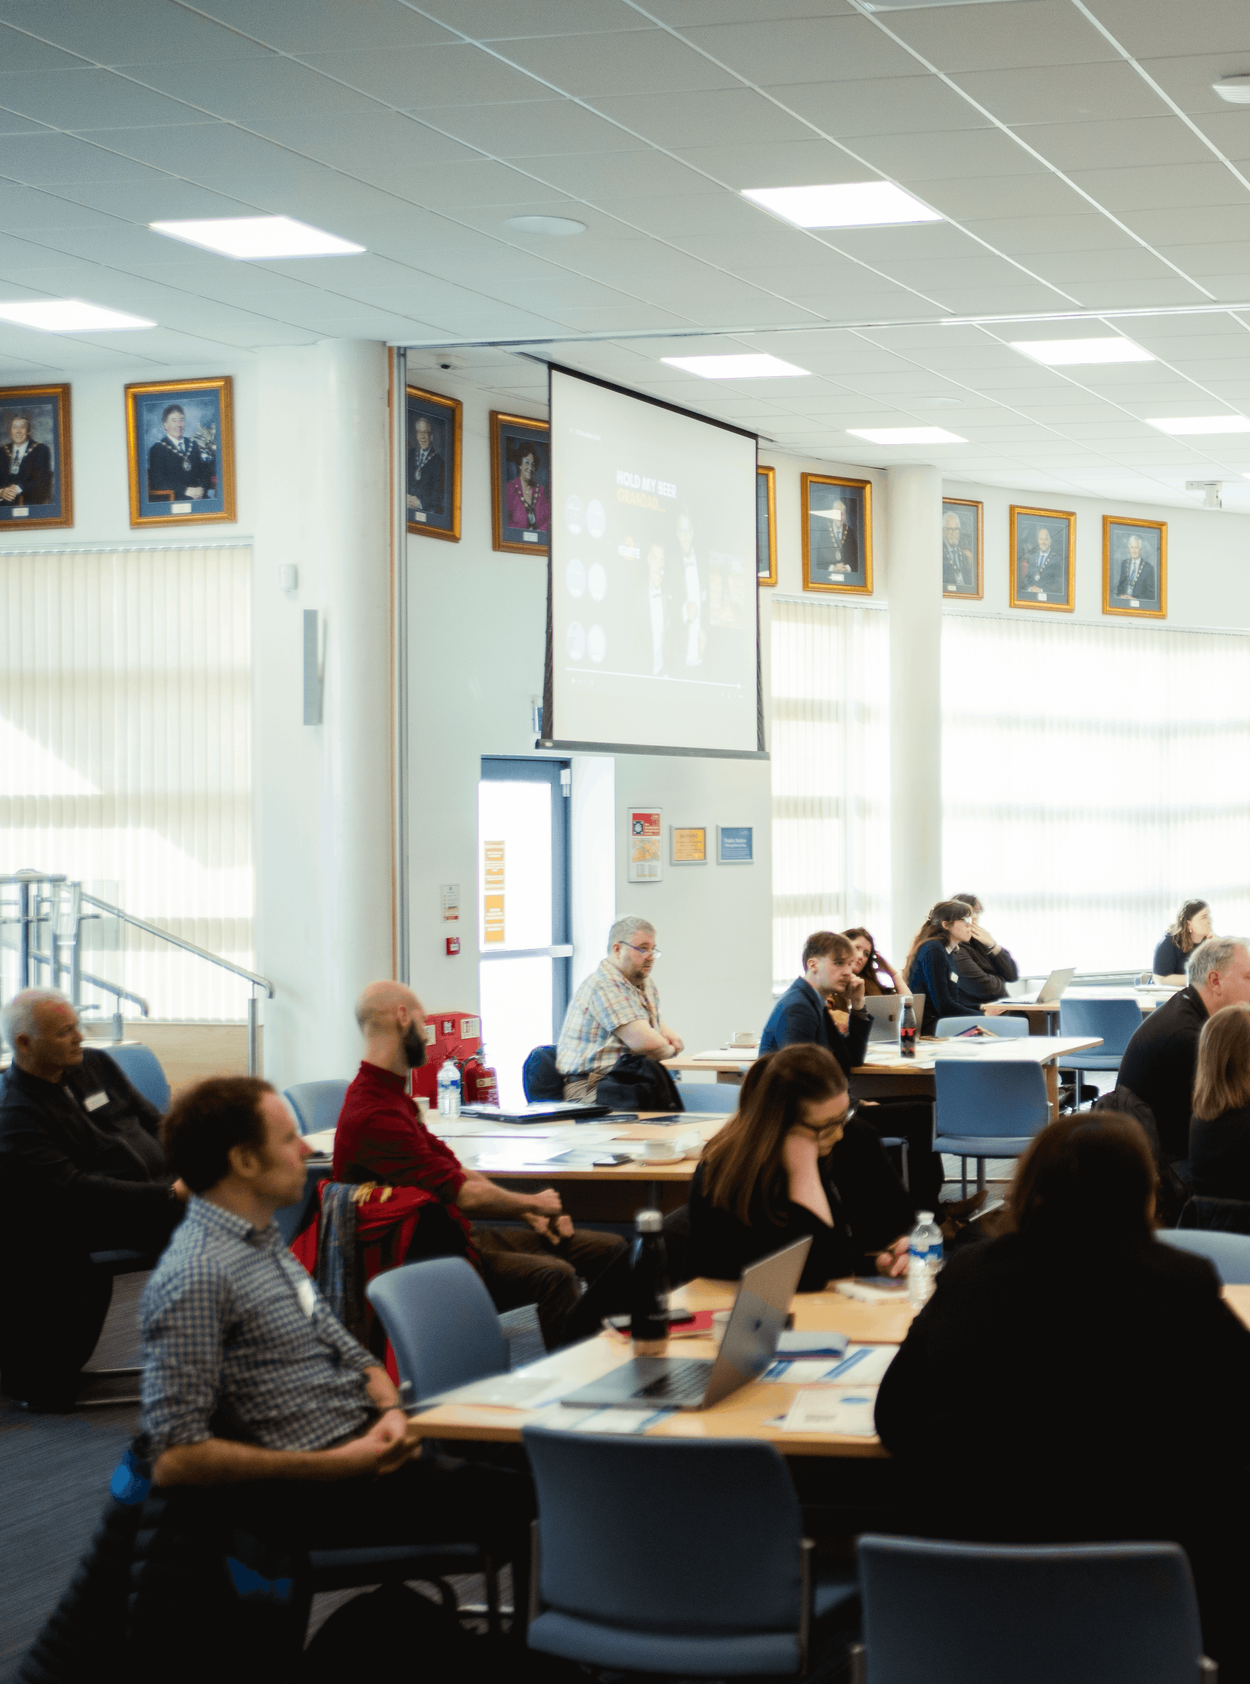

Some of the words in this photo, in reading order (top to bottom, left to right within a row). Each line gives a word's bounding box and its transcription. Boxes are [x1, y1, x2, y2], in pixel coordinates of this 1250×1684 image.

[616, 470, 640, 489] HOLD
[641, 476, 657, 493] MY
[657, 481, 677, 498] BEER
